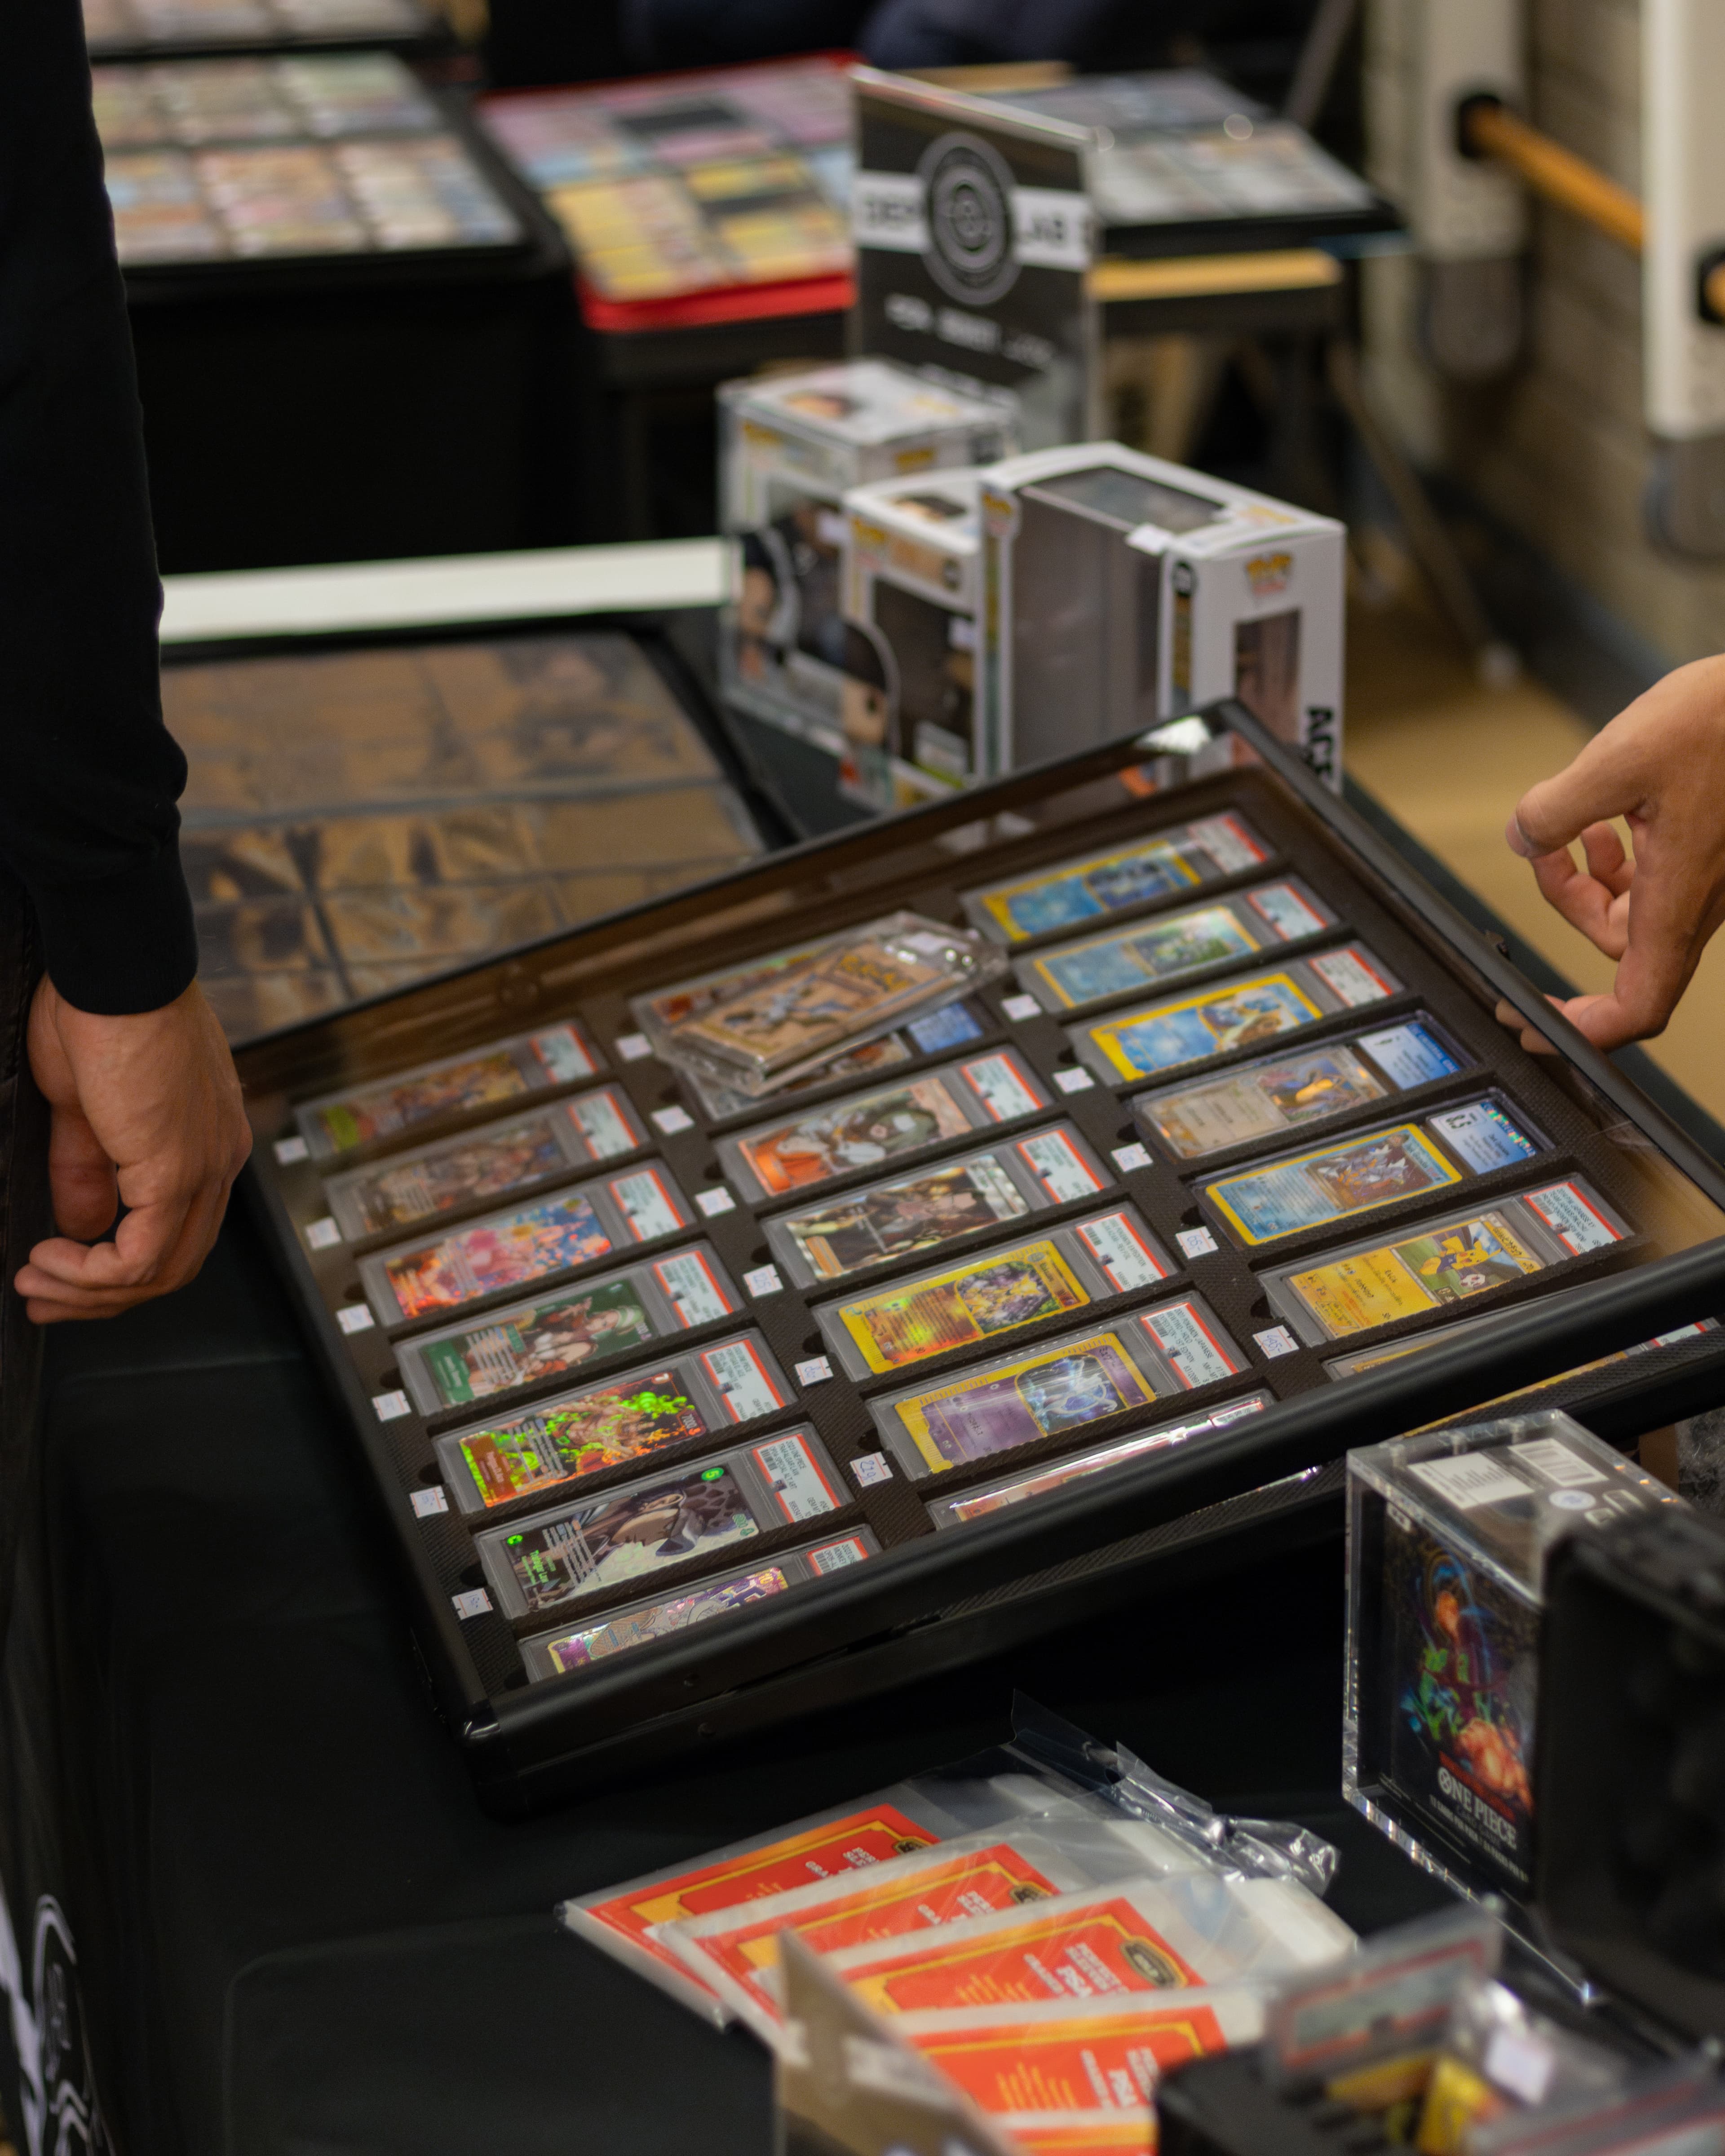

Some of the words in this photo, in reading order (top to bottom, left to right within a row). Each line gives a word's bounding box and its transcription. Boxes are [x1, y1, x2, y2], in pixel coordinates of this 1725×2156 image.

[1127, 1245, 1147, 1267] EXPEDITION
[1181, 1317, 1200, 1338] POKEMON
[1194, 1337, 1215, 1359] JAPANESE
[1179, 1346, 1197, 1363] EDITION
[777, 1442, 795, 1467] TRAFALGAR
[789, 1465, 800, 1476] LAW
[791, 1449, 801, 1458] ONE
[795, 1457, 807, 1469] PIECE
[706, 1469, 720, 1479] 5
[783, 1472, 793, 1482] ALT
[787, 1480, 797, 1489] ART
[806, 1496, 818, 1507] GEM
[811, 1506, 821, 1514] MT
[831, 1546, 849, 1564] MONKEY
[840, 1543, 854, 1555] 2023
[1437, 1766, 1473, 1811] ONE
[1475, 1799, 1517, 1850] PIECE
[1057, 1966, 1092, 1998] PSA
